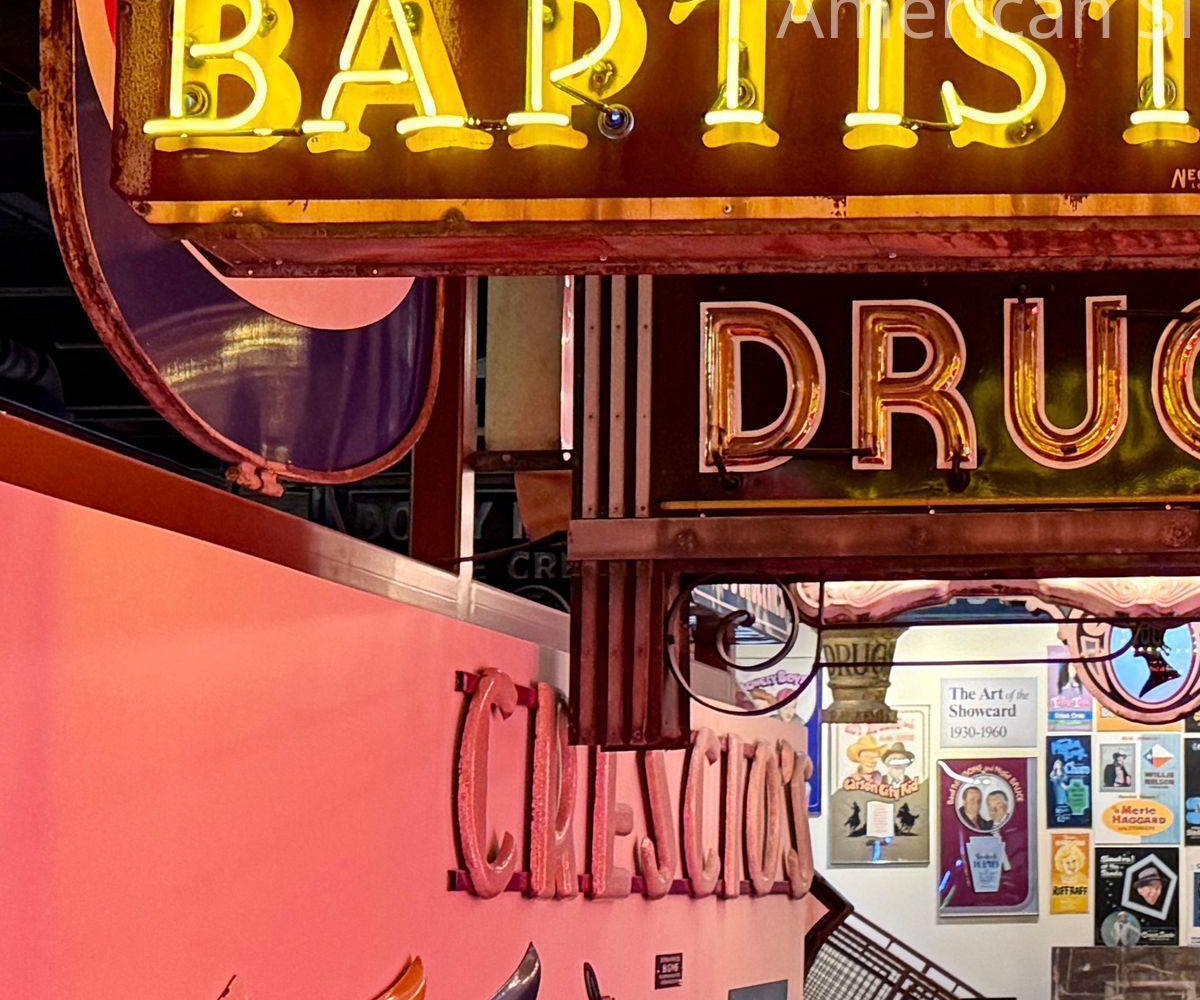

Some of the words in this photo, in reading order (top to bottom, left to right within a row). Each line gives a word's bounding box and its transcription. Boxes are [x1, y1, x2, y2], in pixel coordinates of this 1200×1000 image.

[949, 687, 976, 700] The
[979, 687, 1003, 700] Art
[1005, 688, 1017, 702] of
[1016, 688, 1030, 700] the
[949, 704, 1017, 718] Showcard
[950, 725, 1008, 738] 1930-1960
